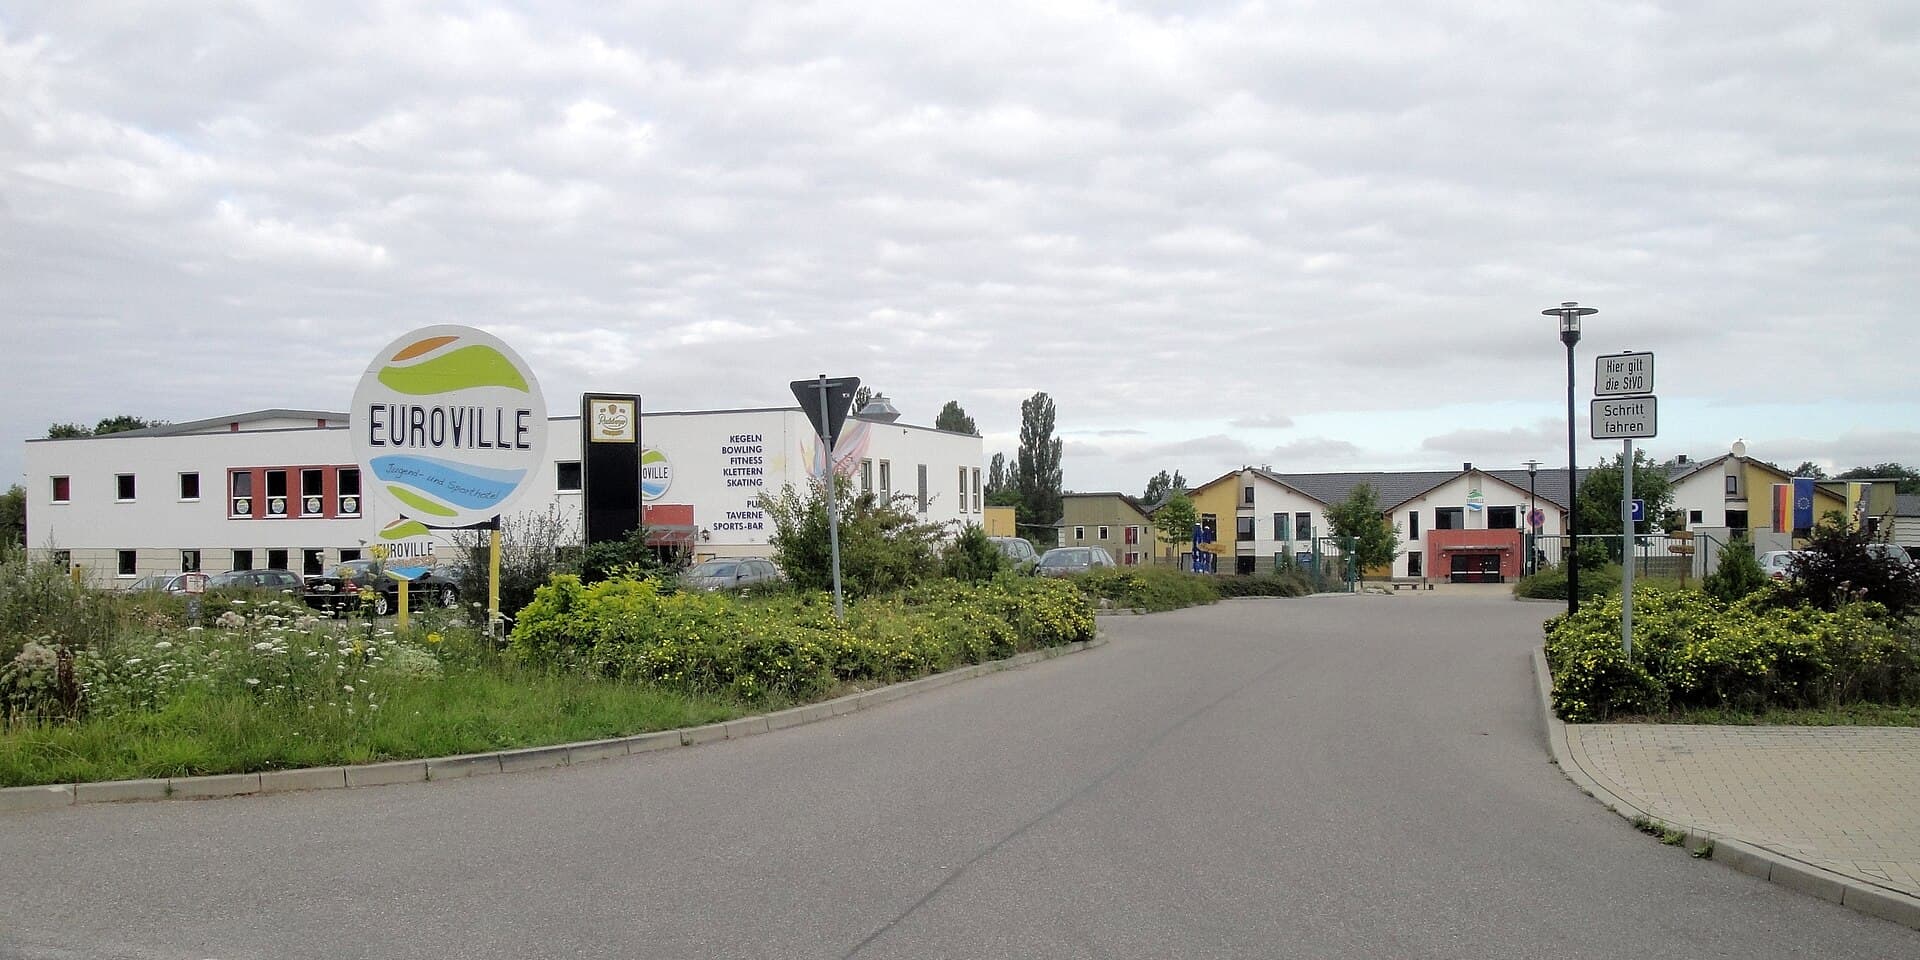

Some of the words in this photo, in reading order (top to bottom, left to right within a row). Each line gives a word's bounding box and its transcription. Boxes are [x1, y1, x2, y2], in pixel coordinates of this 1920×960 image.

[1606, 360, 1624, 373] Hier
[1628, 358, 1643, 375] gilt
[1605, 377, 1619, 391] die
[1622, 376, 1643, 390] StVO
[1604, 403, 1644, 417] Schritt
[368, 402, 532, 451] EUROVILLE
[1605, 420, 1644, 433] fahren
[729, 434, 762, 443] KEGELN
[722, 445, 763, 454] BOWLING
[730, 456, 763, 465] FITNESS
[642, 466, 669, 479] OVILLE
[723, 467, 763, 476] KLETTERN
[385, 463, 425, 479] Jugend-
[426, 475, 446, 486] und
[447, 480, 500, 500] Sporthotel
[727, 478, 763, 487] SKATING
[726, 511, 763, 519] TAVERNE
[713, 522, 764, 531] SPORTS-BAR
[377, 541, 434, 559] UROVILLE
